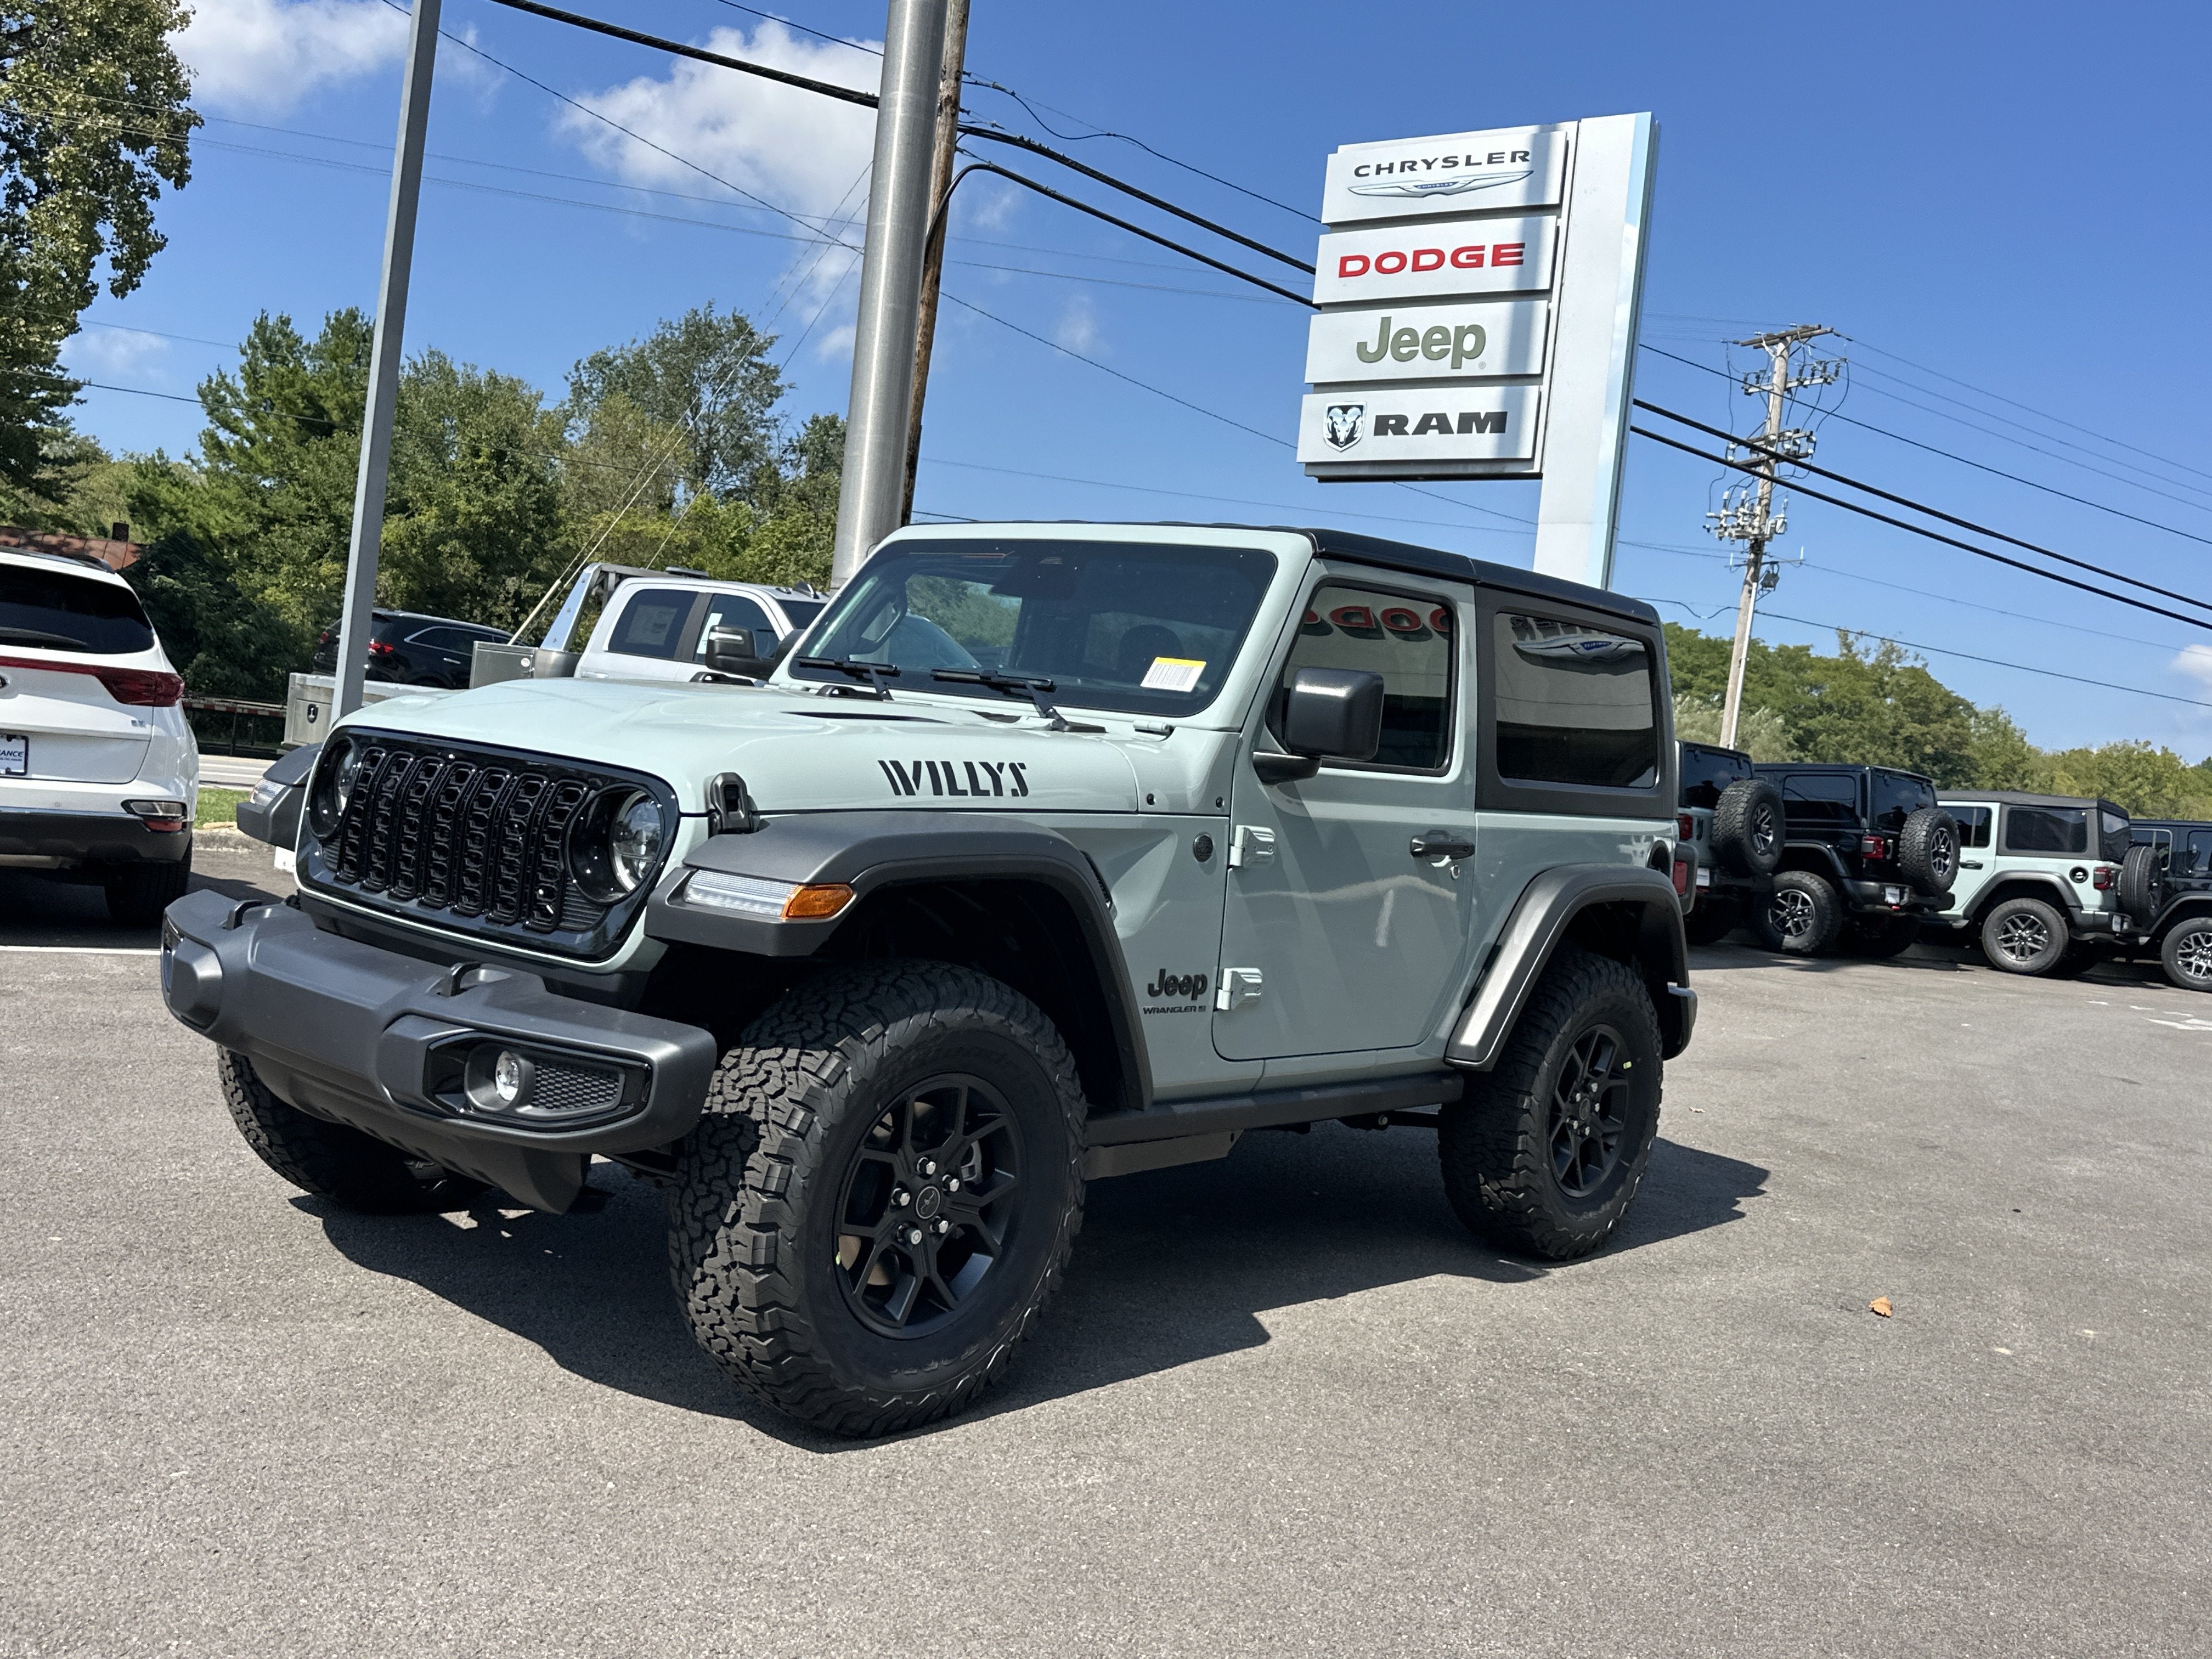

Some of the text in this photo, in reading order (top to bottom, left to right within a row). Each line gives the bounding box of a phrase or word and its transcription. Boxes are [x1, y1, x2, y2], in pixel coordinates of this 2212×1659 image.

[1353, 150, 1530, 178] CHRYSLER
[1339, 242, 1525, 278] DODGE
[1356, 316, 1486, 369] Jeep
[1373, 411, 1508, 436] RAM
[877, 760, 1029, 797] WILLYS
[1148, 968, 1208, 1001] Jeep
[1142, 1006, 1197, 1015] WRANGLER
